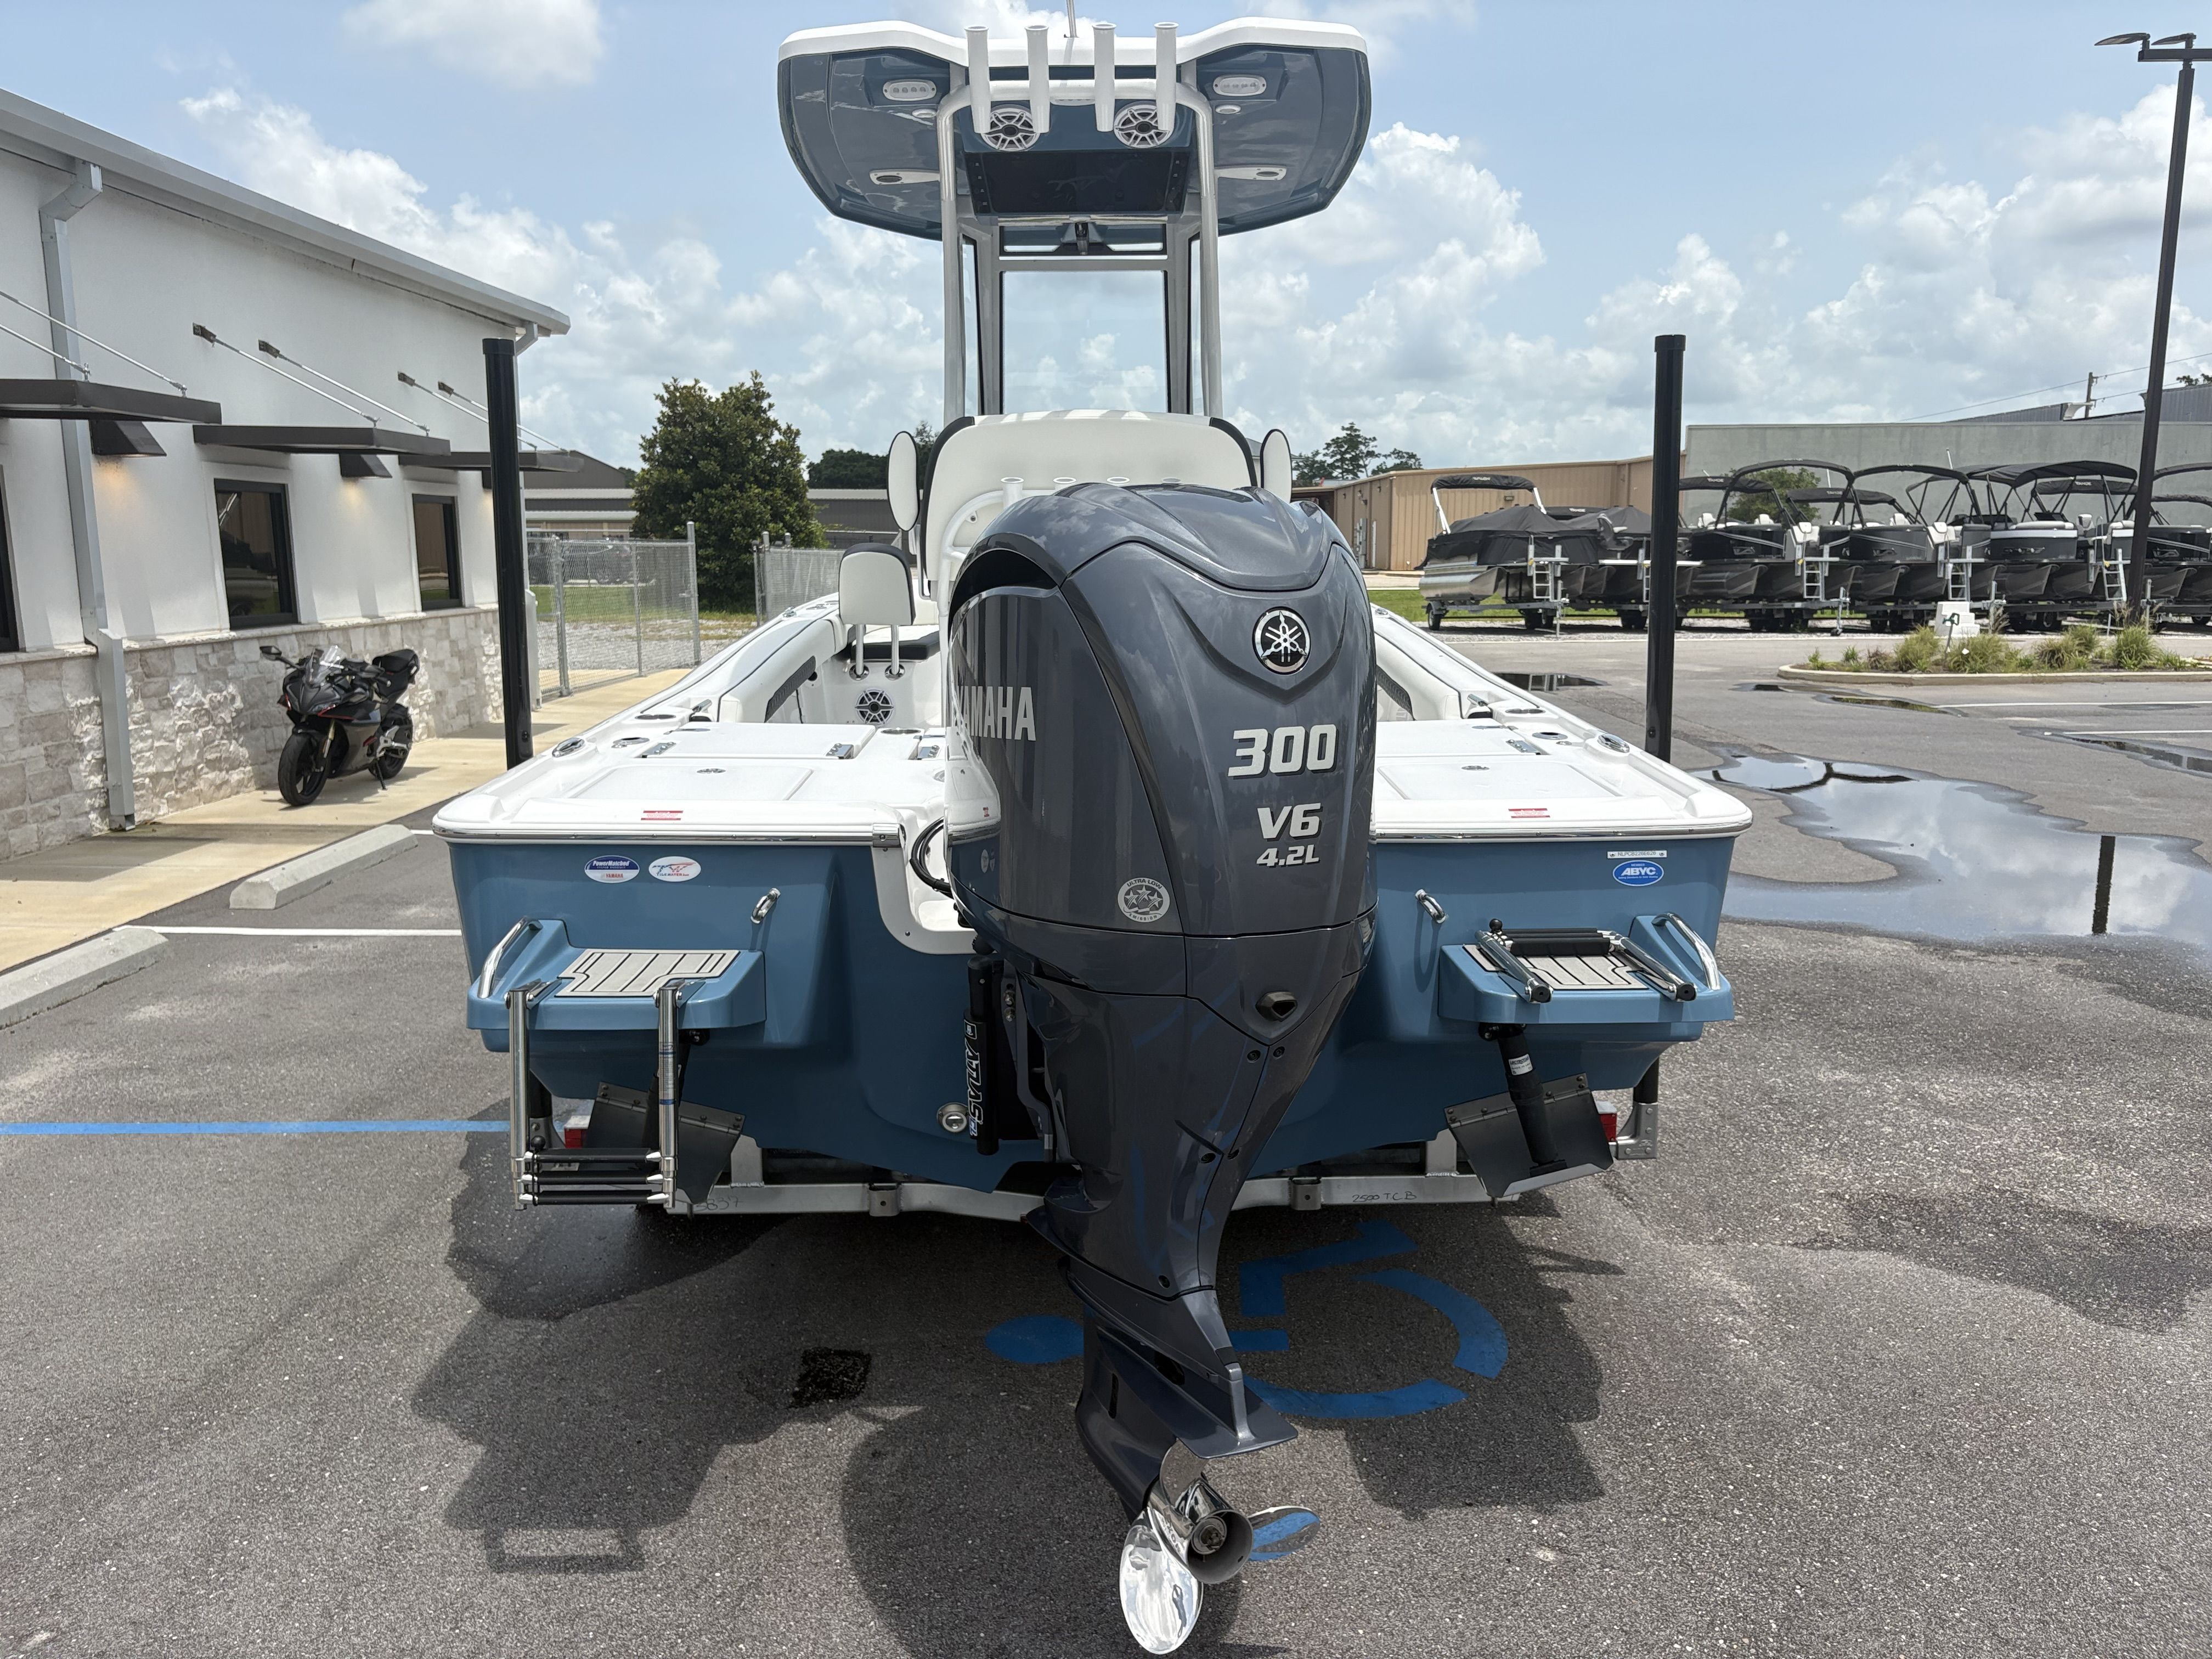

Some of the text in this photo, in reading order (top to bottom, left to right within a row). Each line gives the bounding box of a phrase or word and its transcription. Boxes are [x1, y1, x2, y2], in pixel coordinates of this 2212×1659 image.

[957, 686, 1036, 741] YAMAHA
[1228, 724, 1339, 780] 300
[1257, 803, 1323, 842] V6
[1256, 844, 1319, 867] 4.2L
[1621, 867, 1656, 876] ABYC
[964, 1037, 984, 1124] ATLAS
[1352, 1194, 1380, 1203] 2500
